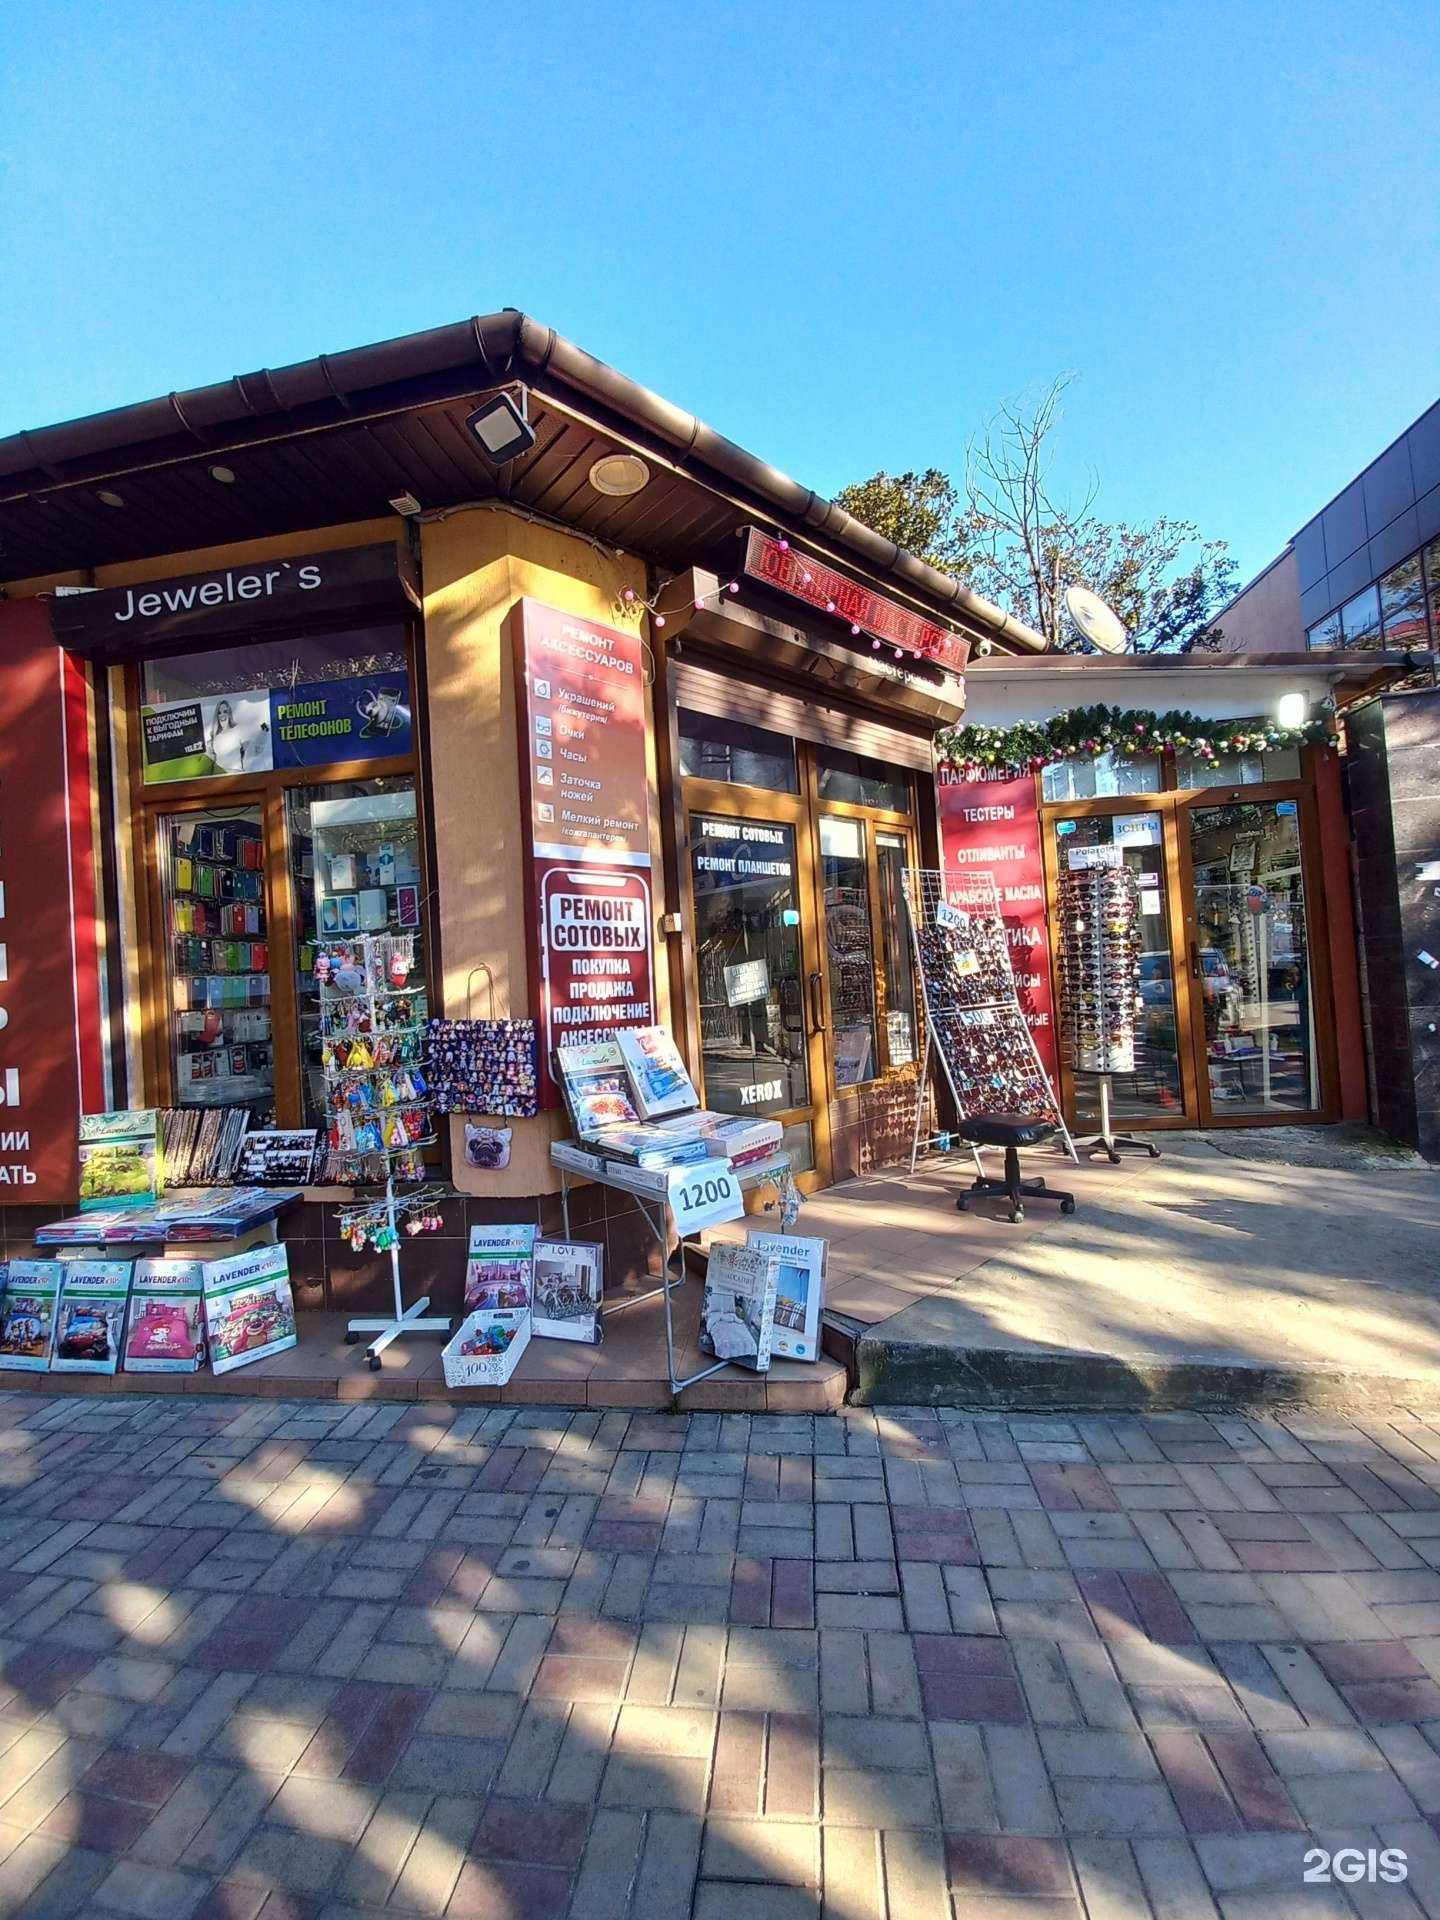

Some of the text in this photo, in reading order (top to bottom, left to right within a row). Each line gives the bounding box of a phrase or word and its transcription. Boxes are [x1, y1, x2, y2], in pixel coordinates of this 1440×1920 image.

[560, 623, 615, 651] РЕМОНТ
[539, 637, 634, 673] АКСЕССУАРОВ
[558, 687, 617, 712] Украшений
[277, 699, 327, 721] РЕМОНТ
[278, 719, 352, 742] ТЕЛЕФОНОВ
[559, 723, 585, 740] Очки
[560, 747, 587, 763] Часы
[560, 772, 601, 790] Заточка
[560, 790, 594, 803] ножей
[561, 808, 640, 832] Мелкий ремонт
[963, 805, 1015, 822] ТЕСТЕРЫ
[702, 822, 784, 844] РЕМОНТ СОТОВЫХ
[697, 856, 791, 876] РЕМОНТ ПЛАНШЕТОВ
[1004, 884, 1041, 900] МАСЛА
[560, 897, 634, 922] РЕМОНТ
[554, 924, 640, 947] СОТОВЫХ
[572, 958, 630, 975] ПОКУПКА
[569, 981, 634, 1000] ПРОДАЖА
[553, 1001, 650, 1024] ПОДКЛЮЧЕНИЕ
[740, 1079, 782, 1105] XEROX
[679, 1177, 731, 1212] 1200
[474, 1238, 511, 1248] LAVENDER
[551, 1245, 577, 1257] LOVE
[757, 1239, 810, 1258] Lavender
[8, 1276, 37, 1285] LAVENDER
[70, 1276, 105, 1286] LAVENDER
[139, 1275, 176, 1285] LAVENDER
[213, 1264, 261, 1285] LAVENDER
